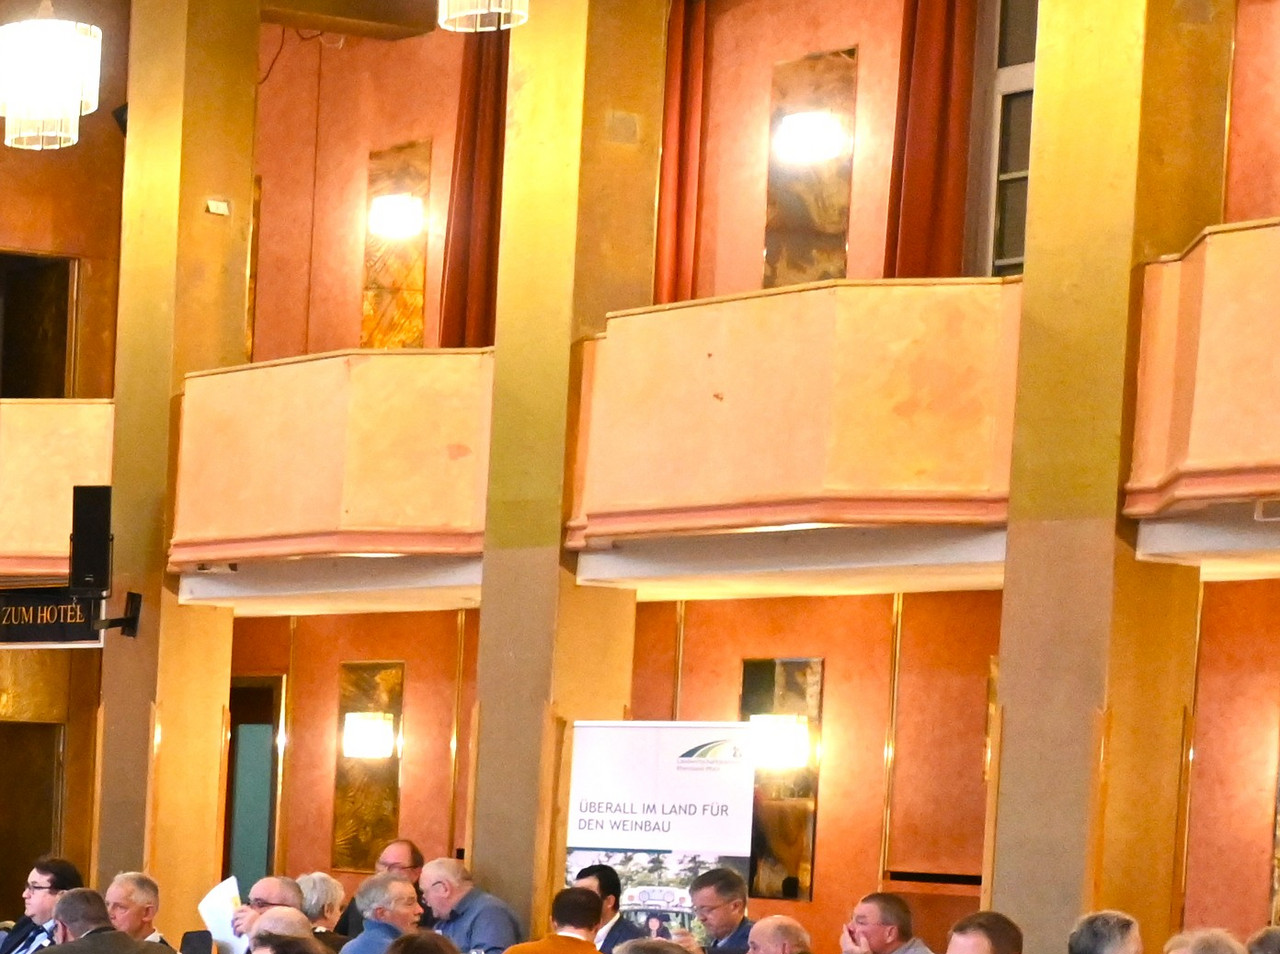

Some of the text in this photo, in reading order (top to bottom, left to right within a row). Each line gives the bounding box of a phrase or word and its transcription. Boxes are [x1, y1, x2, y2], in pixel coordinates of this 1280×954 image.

[1, 607, 34, 625] ZUM
[37, 604, 85, 624] HOTEL
[578, 799, 729, 817] ÜBERALL IM LAND FÜR
[578, 818, 672, 833] DEN WEINBAU
